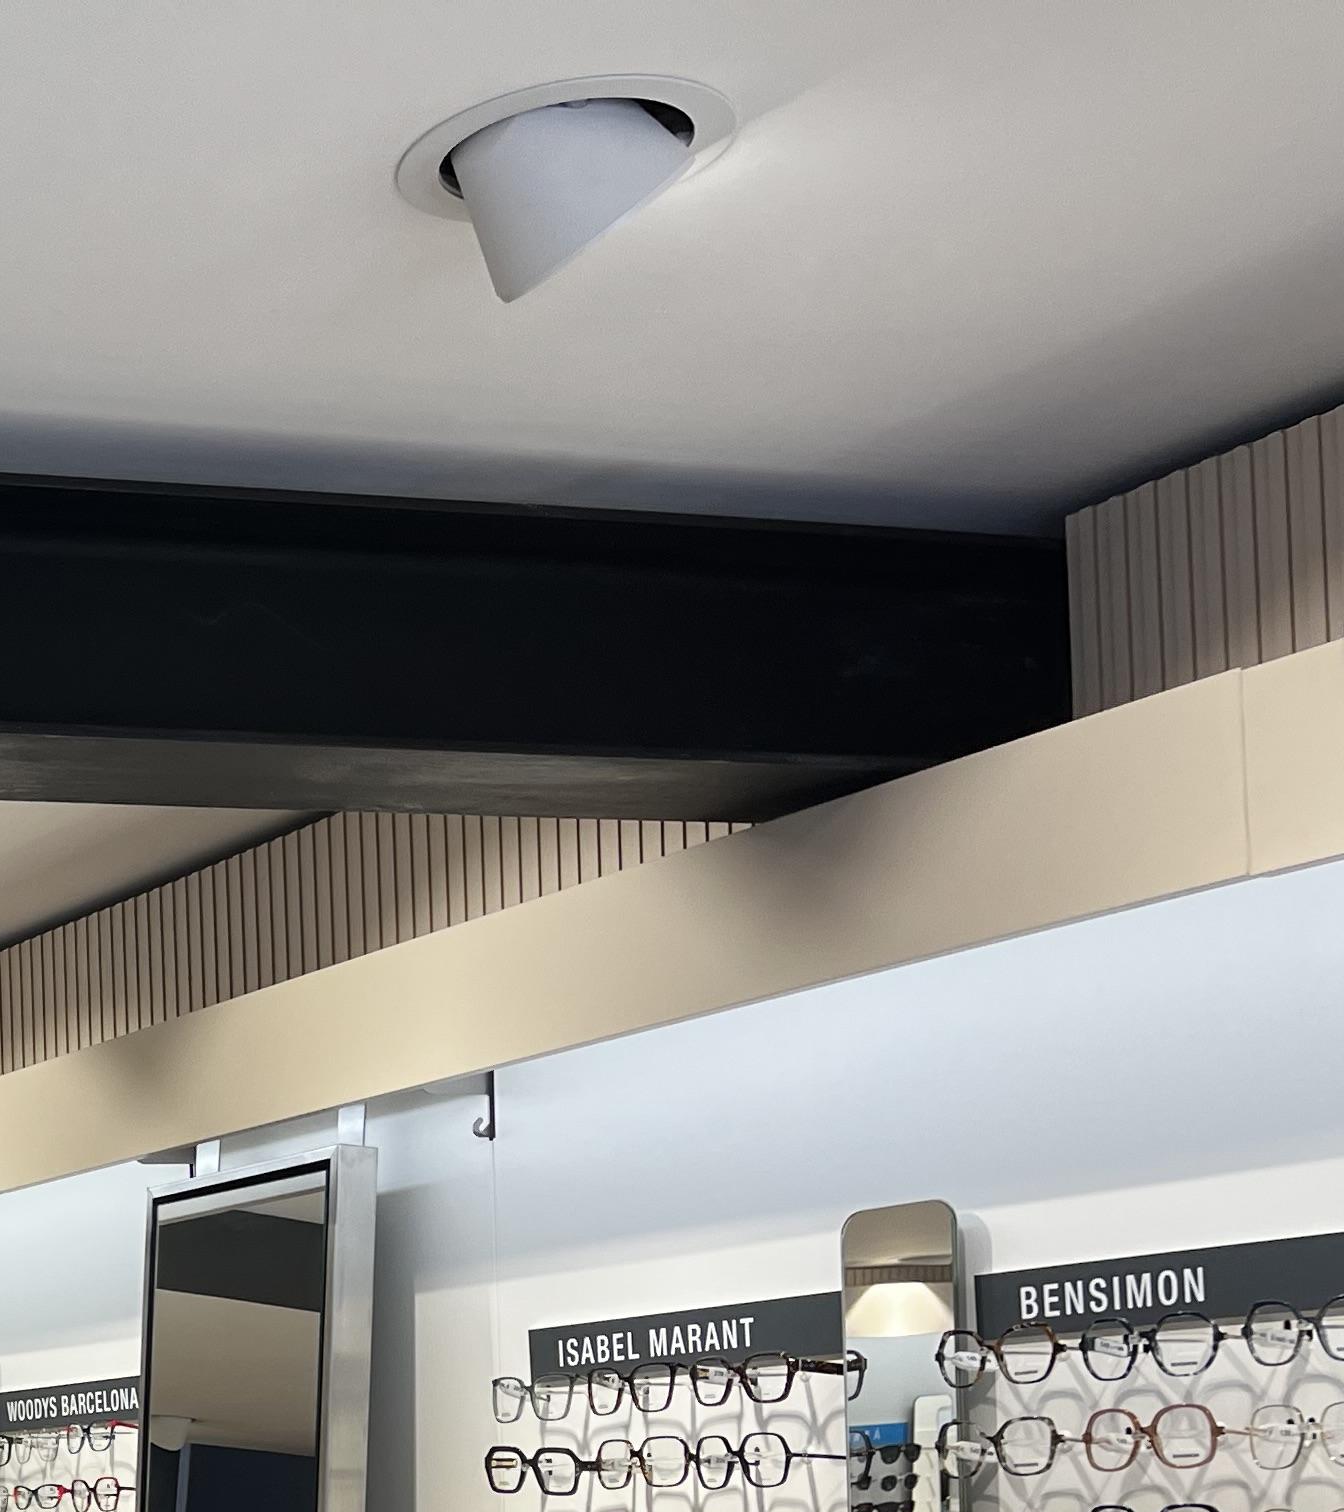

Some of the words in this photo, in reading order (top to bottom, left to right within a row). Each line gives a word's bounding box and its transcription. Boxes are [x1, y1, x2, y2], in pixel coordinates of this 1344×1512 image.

[1019, 1267, 1206, 1320] BENSIMON
[558, 1331, 640, 1368] ISABEL
[648, 1317, 754, 1358] MARANT
[6, 1396, 57, 1422] WOODYS
[61, 1387, 139, 1416] BARCELONA
